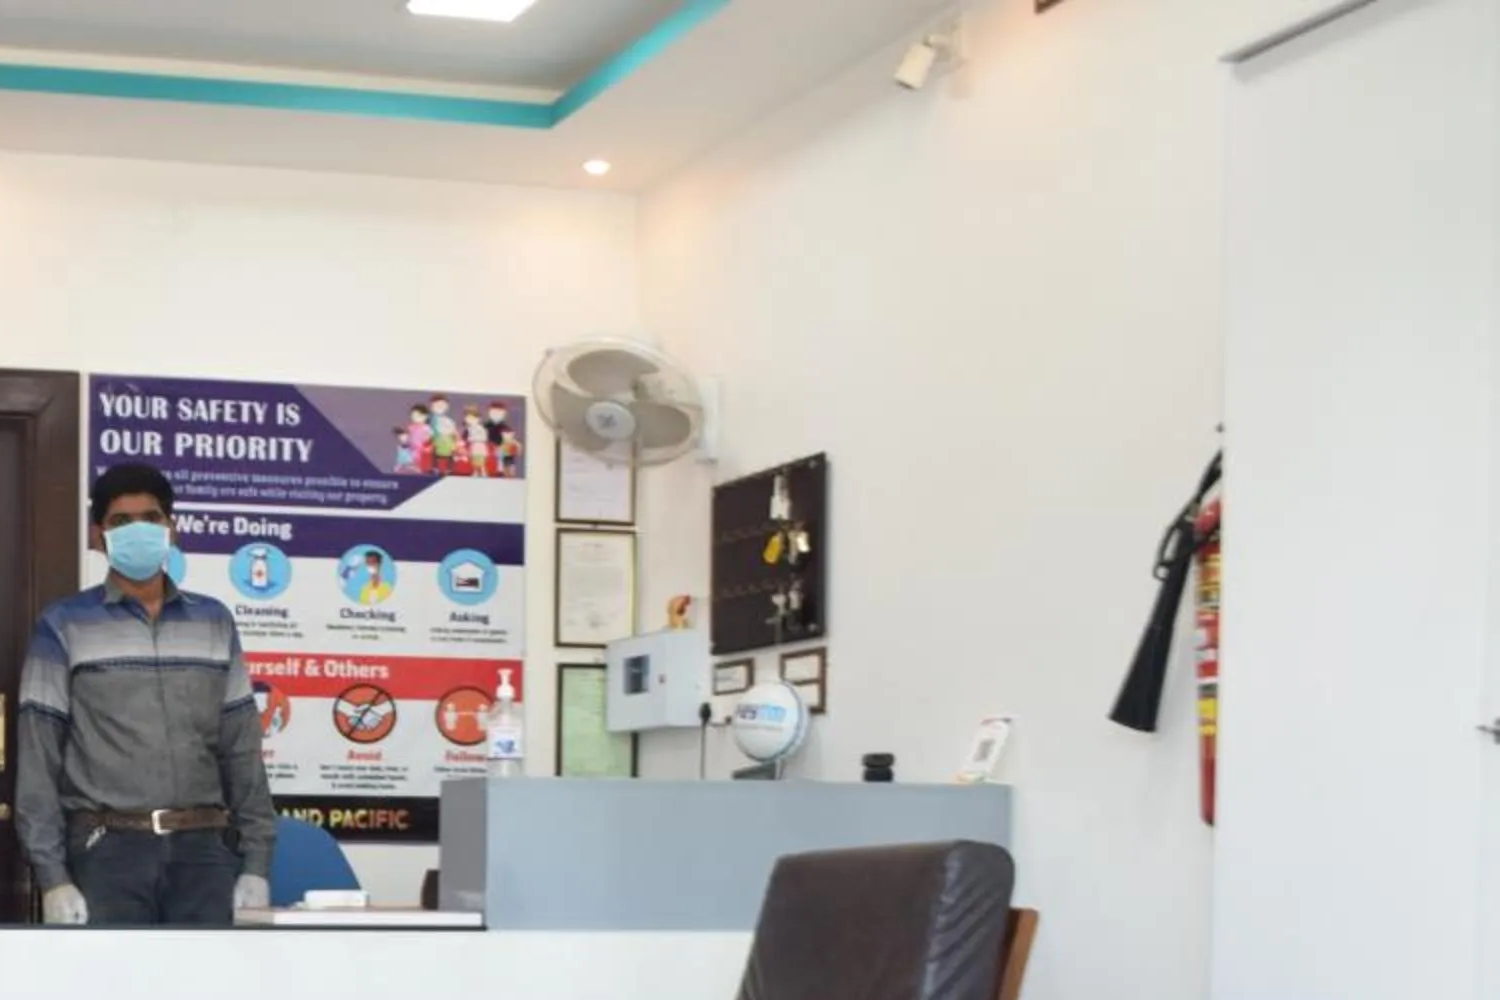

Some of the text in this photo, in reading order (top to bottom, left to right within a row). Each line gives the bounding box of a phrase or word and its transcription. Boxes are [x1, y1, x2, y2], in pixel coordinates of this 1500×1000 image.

[98, 392, 301, 426] YOUR SAFETY IS
[99, 428, 314, 463] OUR PRIORITY
[233, 516, 293, 541] Doing
[235, 605, 288, 619] Cleaning
[339, 607, 396, 622] Checking
[450, 611, 490, 626] Asking
[304, 658, 320, 677] &
[323, 659, 390, 679] Others
[328, 808, 411, 831] PACIFIC
